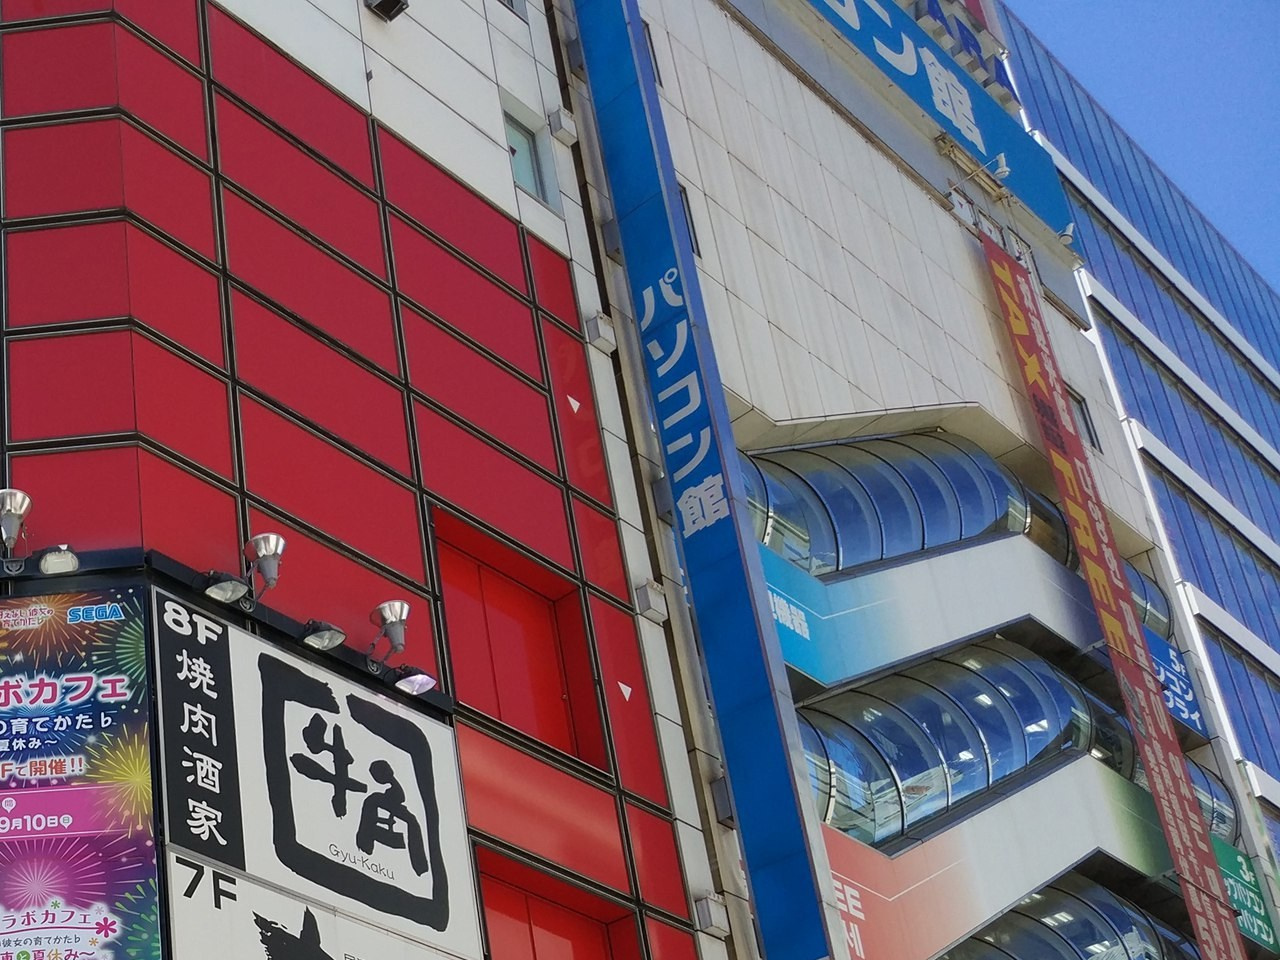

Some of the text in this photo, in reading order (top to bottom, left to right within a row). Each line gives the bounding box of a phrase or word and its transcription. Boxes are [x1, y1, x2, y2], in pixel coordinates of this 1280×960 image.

[641, 267, 731, 539] パソコン館
[67, 603, 125, 624] SEGA
[163, 600, 223, 645] 8F
[1169, 648, 1186, 676] 5F
[175, 649, 227, 846] 焼肉酒家
[290, 713, 429, 877] 牛角
[175, 856, 238, 910] 7F
[328, 842, 396, 882] Gyu-Kaku
[1237, 855, 1255, 885] 3F
